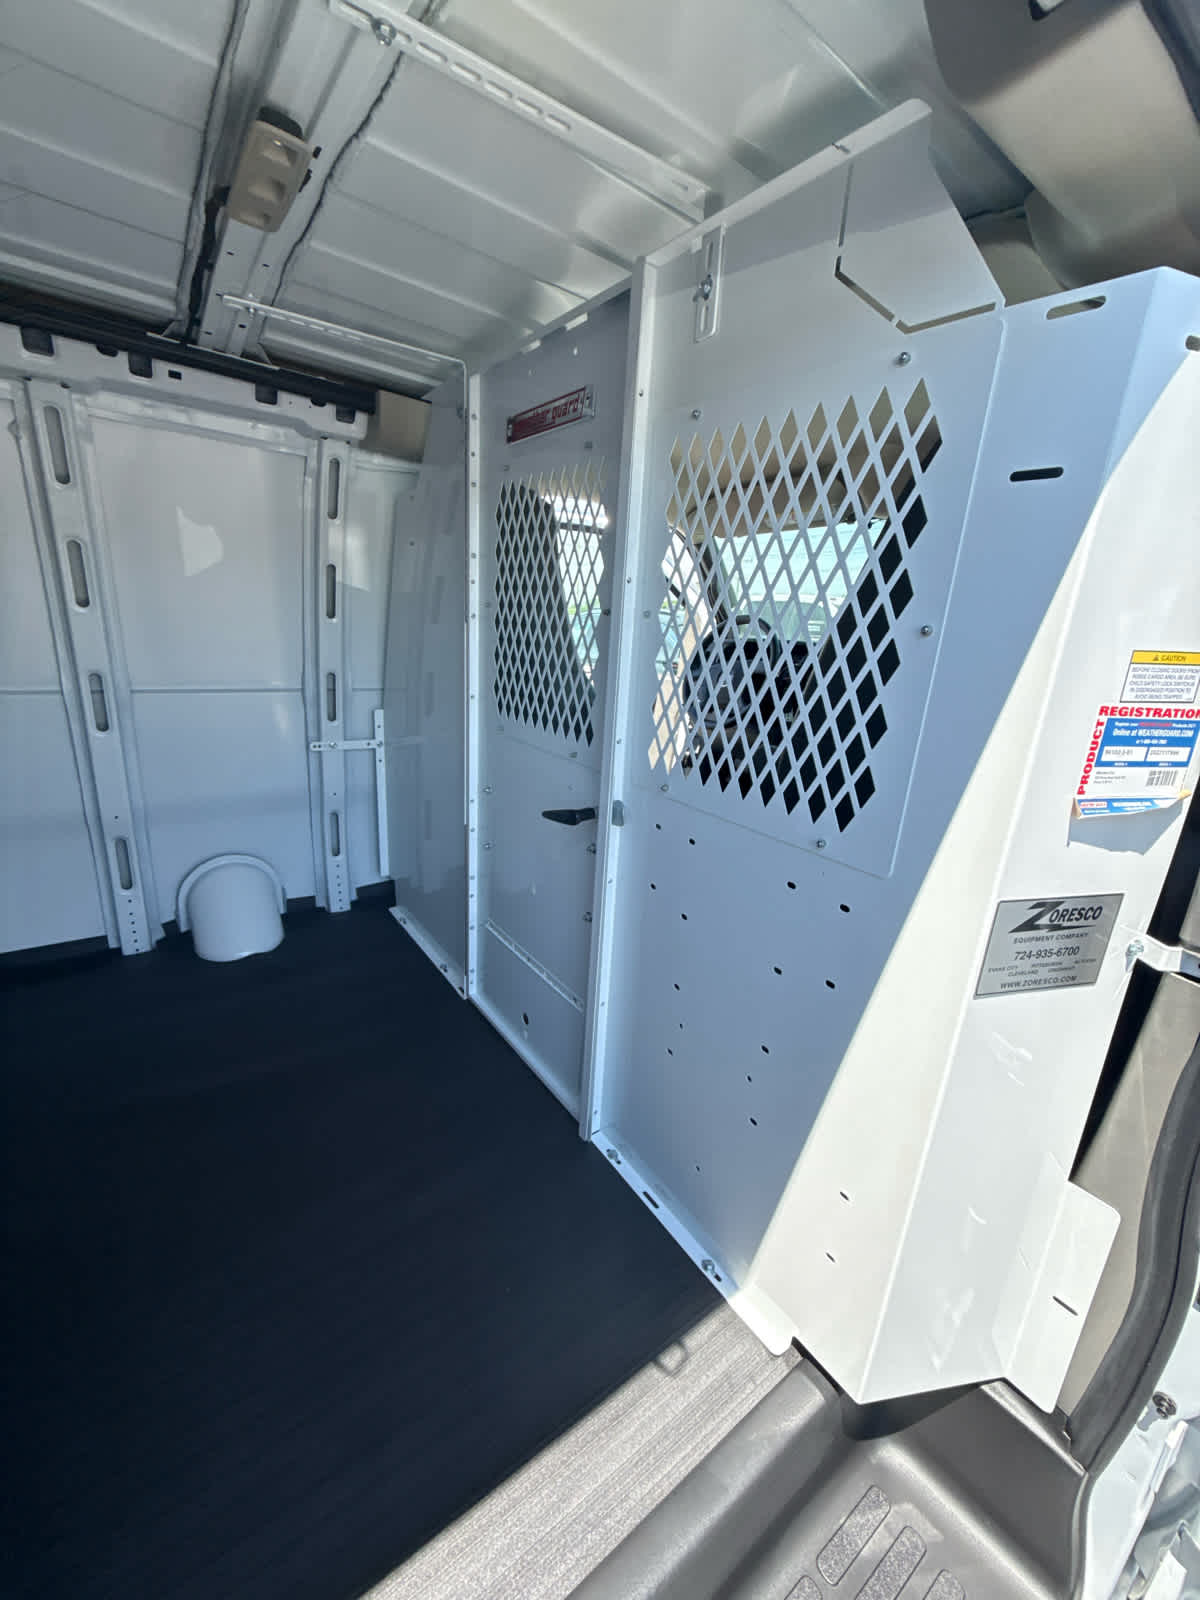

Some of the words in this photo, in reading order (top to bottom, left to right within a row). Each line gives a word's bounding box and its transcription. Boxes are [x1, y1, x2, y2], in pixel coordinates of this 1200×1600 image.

[1113, 728, 1130, 736] Online
[1131, 728, 1138, 736] at
[1077, 718, 1104, 795] PRODUCT
[1008, 900, 1104, 933] ZORESCO
[1013, 934, 1054, 944] EQUIPMENT
[1055, 932, 1089, 941] COMPANY
[1014, 946, 1080, 961] 724-935-6700
[1000, 975, 1078, 990] WWW.ZORESCO.COM
